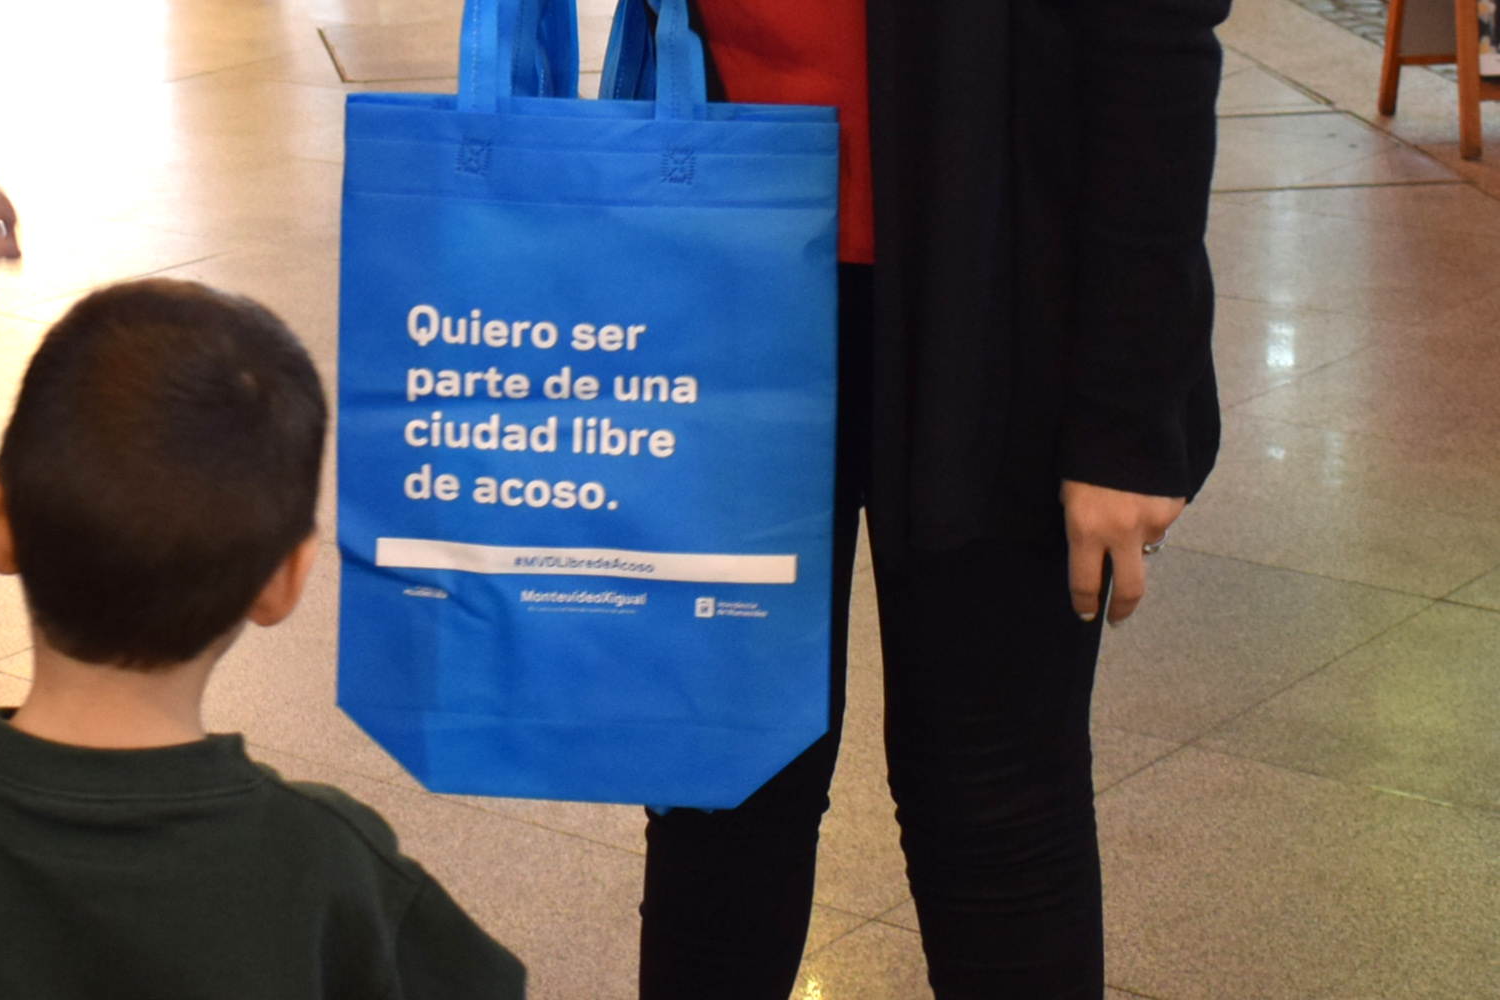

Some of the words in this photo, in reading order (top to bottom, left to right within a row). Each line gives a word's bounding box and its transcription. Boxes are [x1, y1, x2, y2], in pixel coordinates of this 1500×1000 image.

[406, 303, 559, 349] Quiero
[570, 322, 647, 352] ser
[406, 366, 531, 402] parte
[542, 365, 601, 400] de
[612, 375, 699, 404] una
[403, 410, 559, 453] ciudad
[571, 416, 678, 458] libre
[403, 463, 461, 501] de
[471, 475, 619, 510] acoso.
[513, 556, 656, 573] #MVDLibredeAcoso
